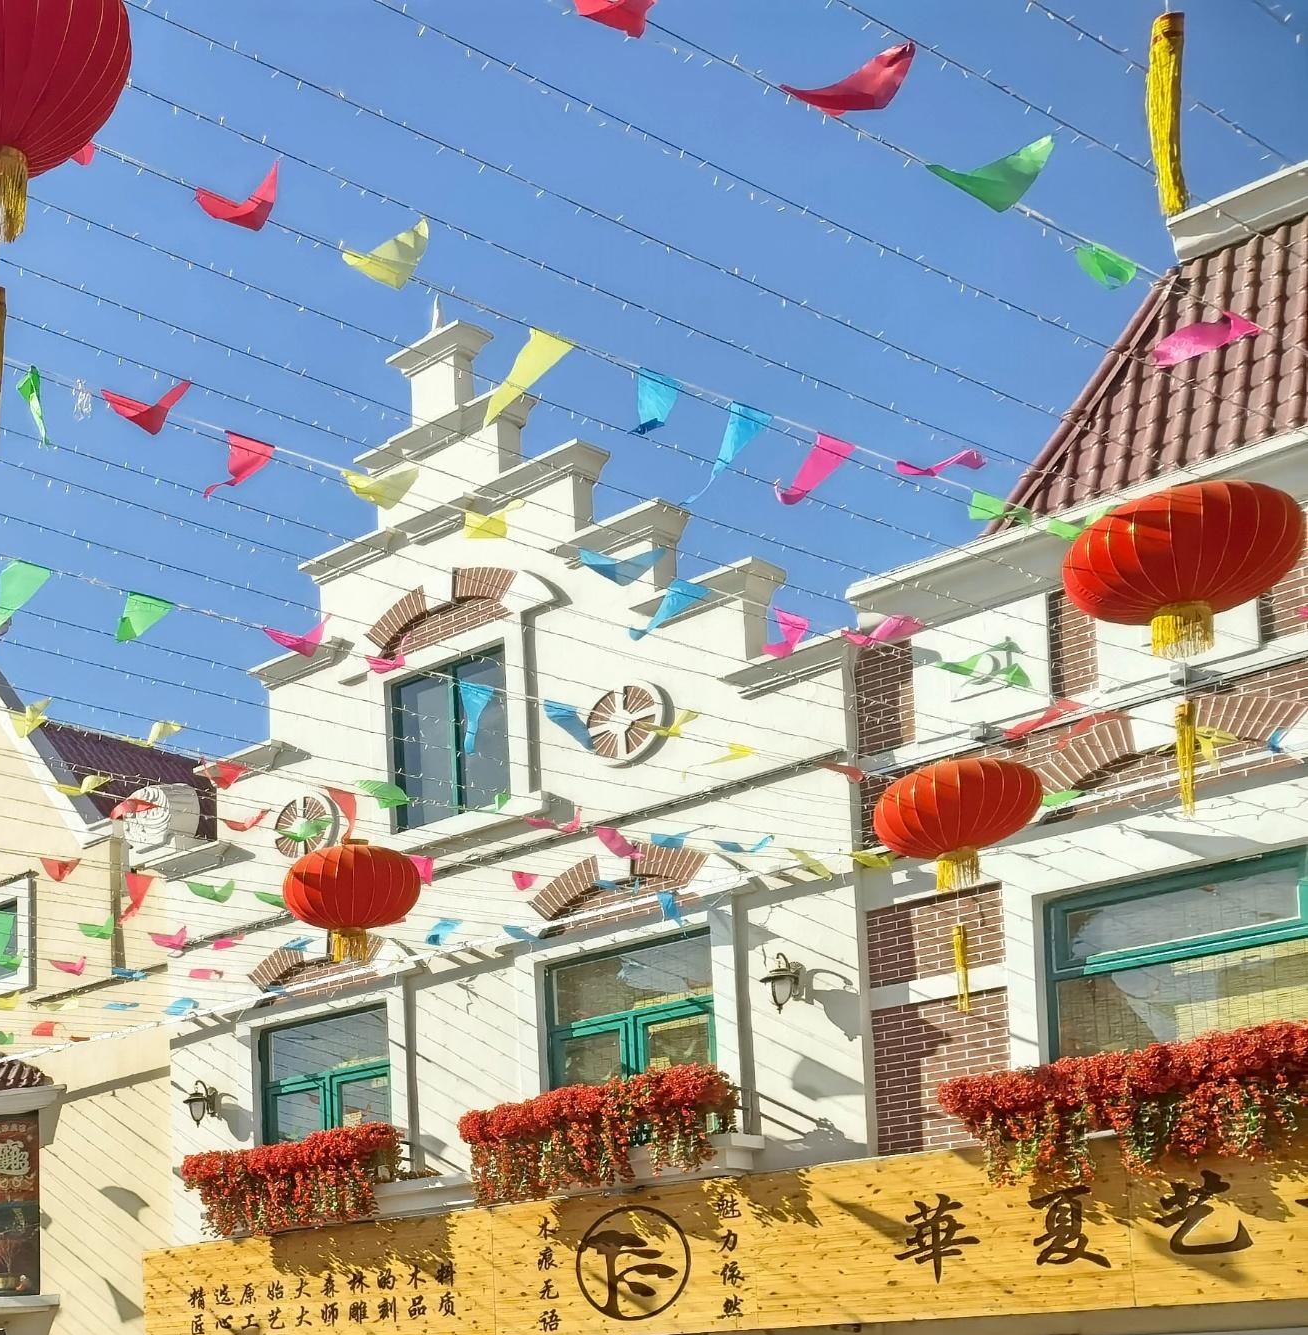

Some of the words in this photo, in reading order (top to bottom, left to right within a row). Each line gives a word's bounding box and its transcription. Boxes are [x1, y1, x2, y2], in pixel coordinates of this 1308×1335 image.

[537, 1216, 562, 1333] 木痕无语
[894, 1168, 1308, 1284] 華夏艺
[188, 1261, 457, 1310] 精选原始大森林的木料
